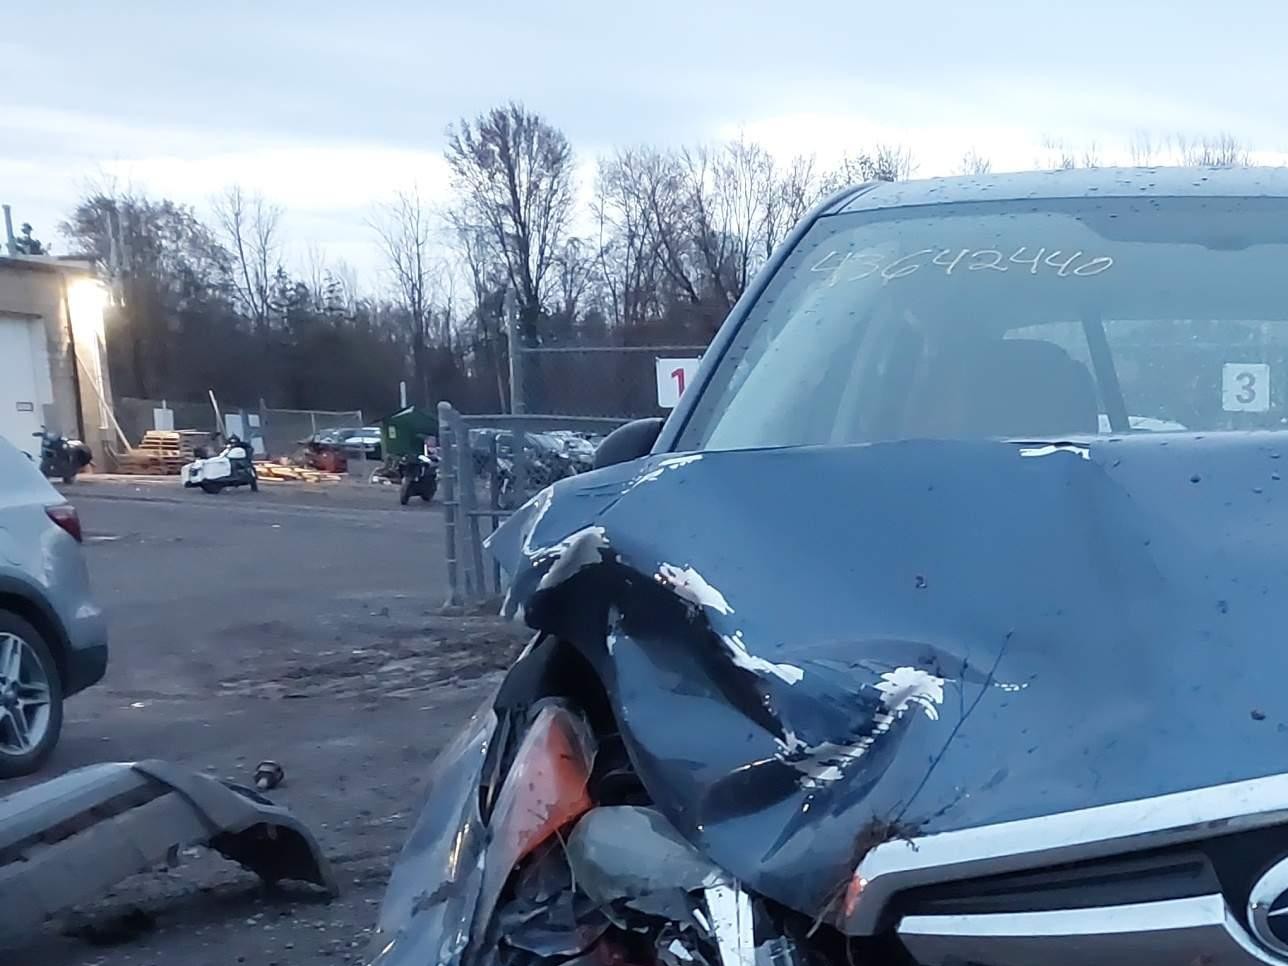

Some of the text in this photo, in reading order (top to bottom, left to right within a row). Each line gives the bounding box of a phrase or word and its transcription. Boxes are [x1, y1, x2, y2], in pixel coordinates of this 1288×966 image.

[810, 246, 1113, 287] 43642440
[671, 367, 686, 398] 1
[1235, 372, 1257, 404] 3
